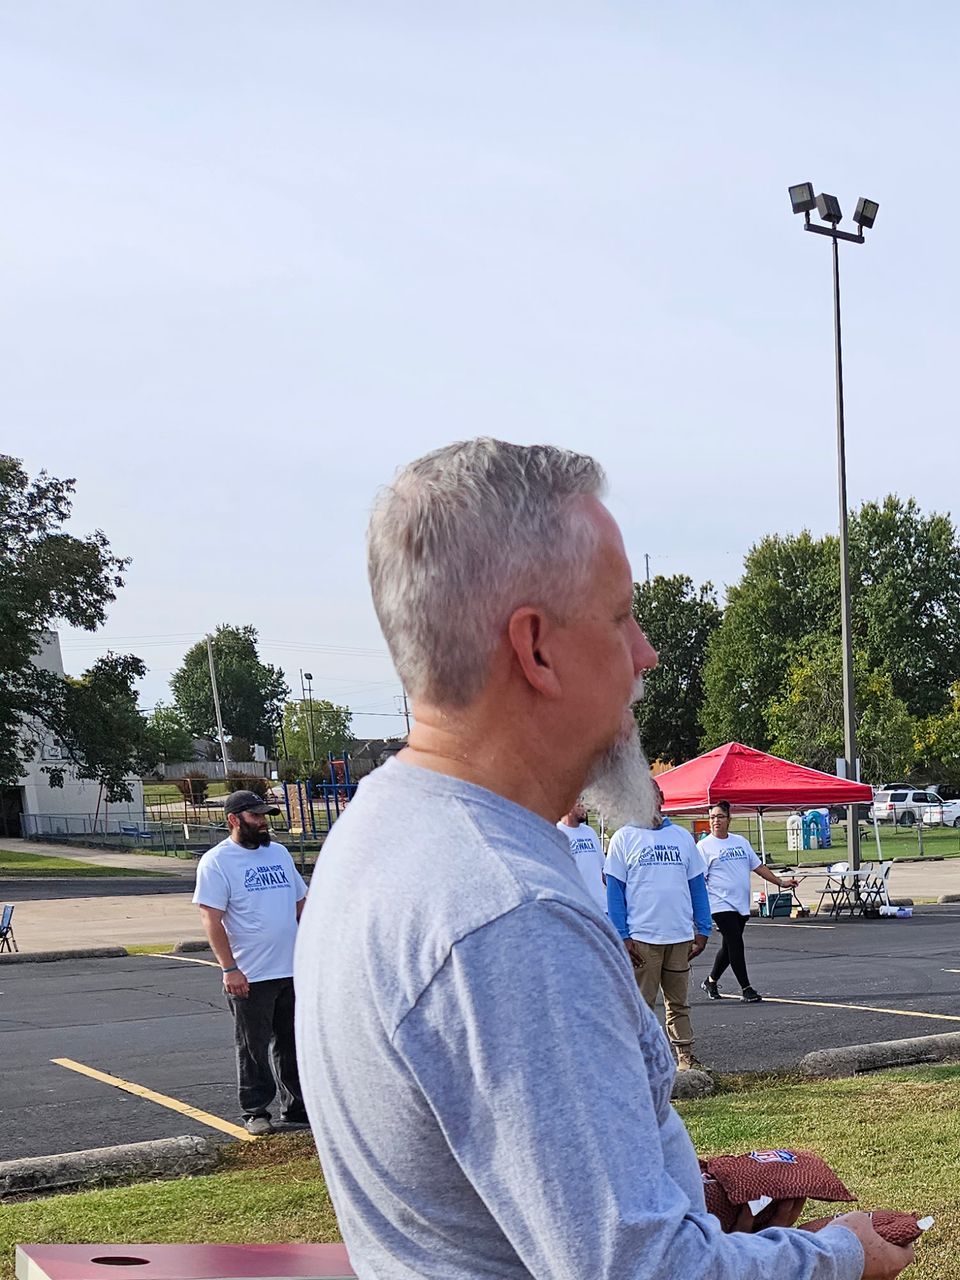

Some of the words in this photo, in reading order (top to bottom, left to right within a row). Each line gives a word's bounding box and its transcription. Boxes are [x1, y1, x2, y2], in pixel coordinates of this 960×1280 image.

[577, 842, 596, 850] WALK
[654, 850, 682, 862] WALK
[728, 849, 747, 857] WALK
[258, 871, 289, 886] WALK
